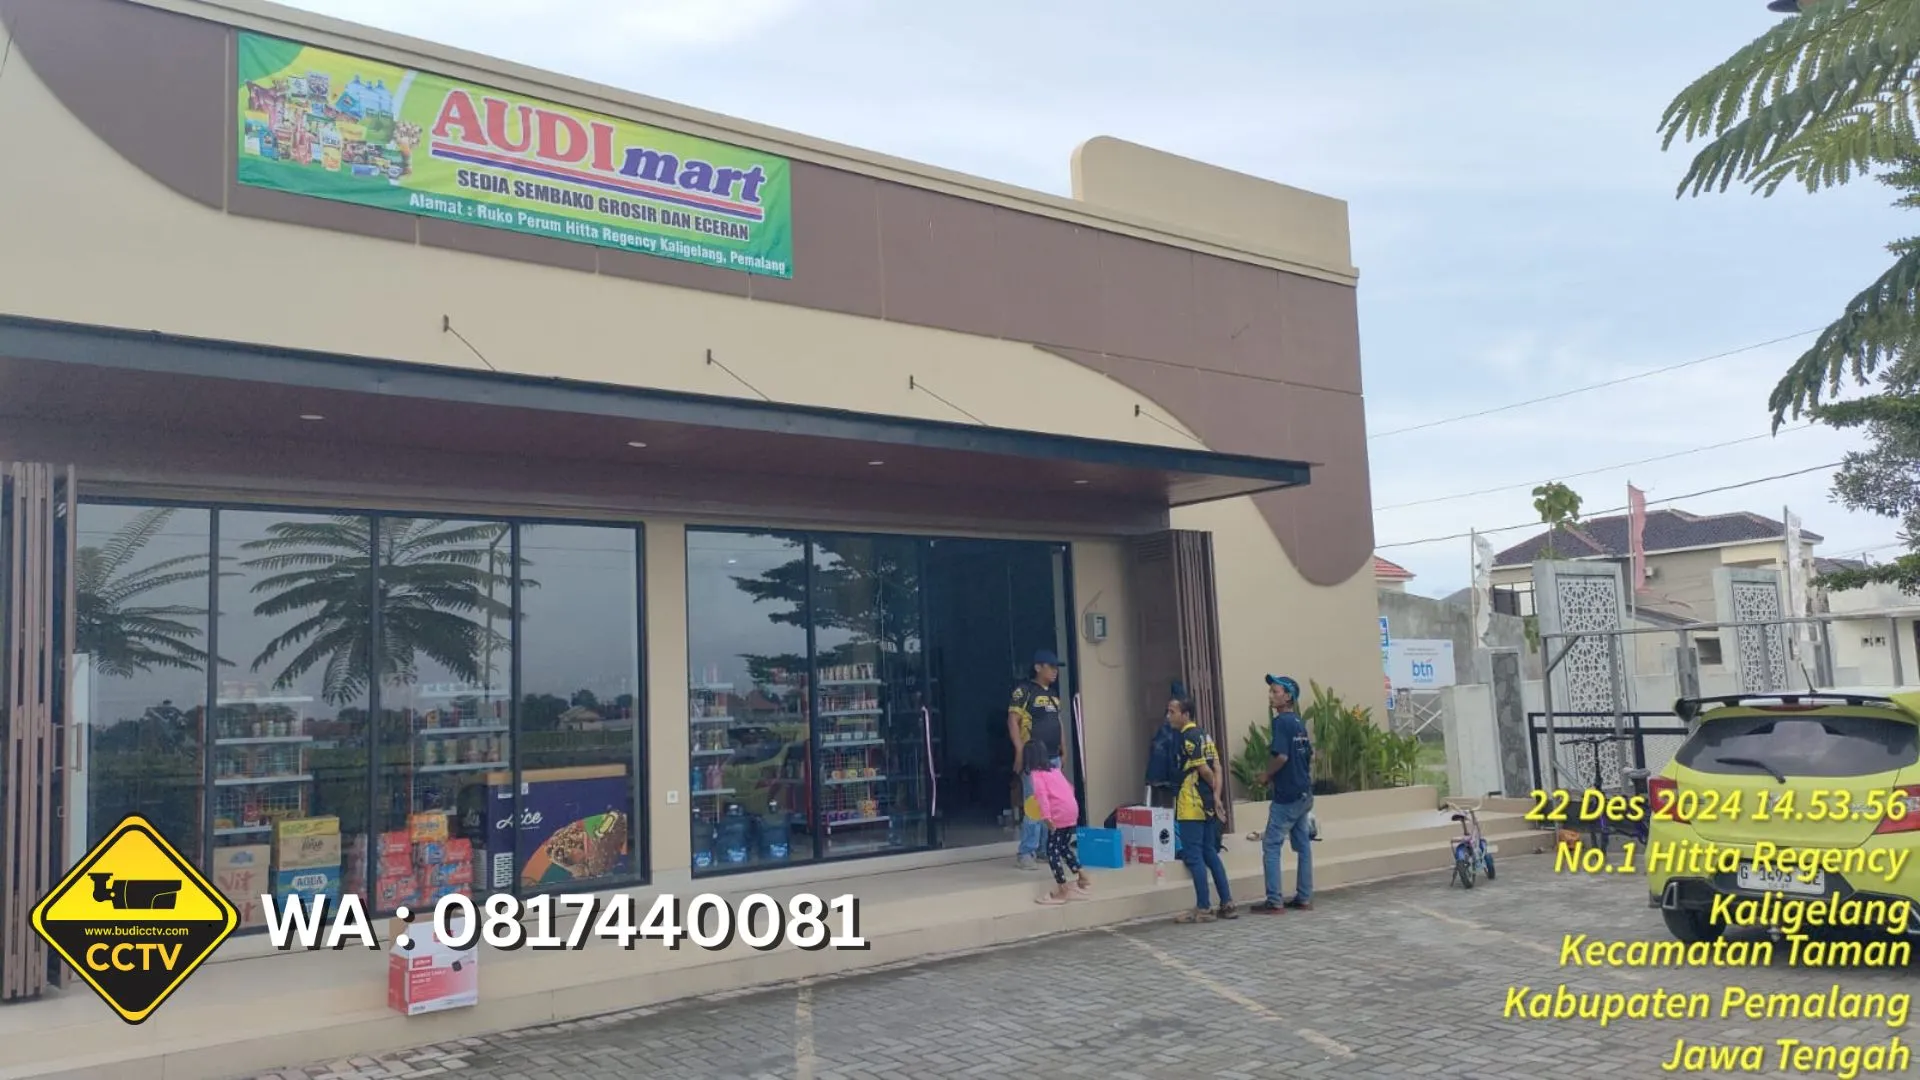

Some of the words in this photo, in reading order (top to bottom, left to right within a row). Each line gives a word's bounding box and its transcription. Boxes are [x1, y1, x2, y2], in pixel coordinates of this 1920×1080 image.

[431, 90, 615, 172] AUDI
[619, 147, 766, 203] mart
[409, 192, 464, 215] Alamat
[477, 204, 514, 225] Ruko
[518, 211, 562, 233] Perum
[565, 219, 600, 240] Hitta
[602, 226, 658, 250] Regency
[660, 238, 728, 264] Kaligelang,
[730, 251, 787, 275] Pemalang
[457, 169, 510, 195] SEDIA
[514, 180, 594, 211] SEMBAKO
[598, 196, 658, 223] GROSIR
[660, 209, 691, 230] DAN
[694, 216, 750, 241] ECERAN
[1412, 660, 1433, 677] btn
[1740, 865, 1748, 879] G
